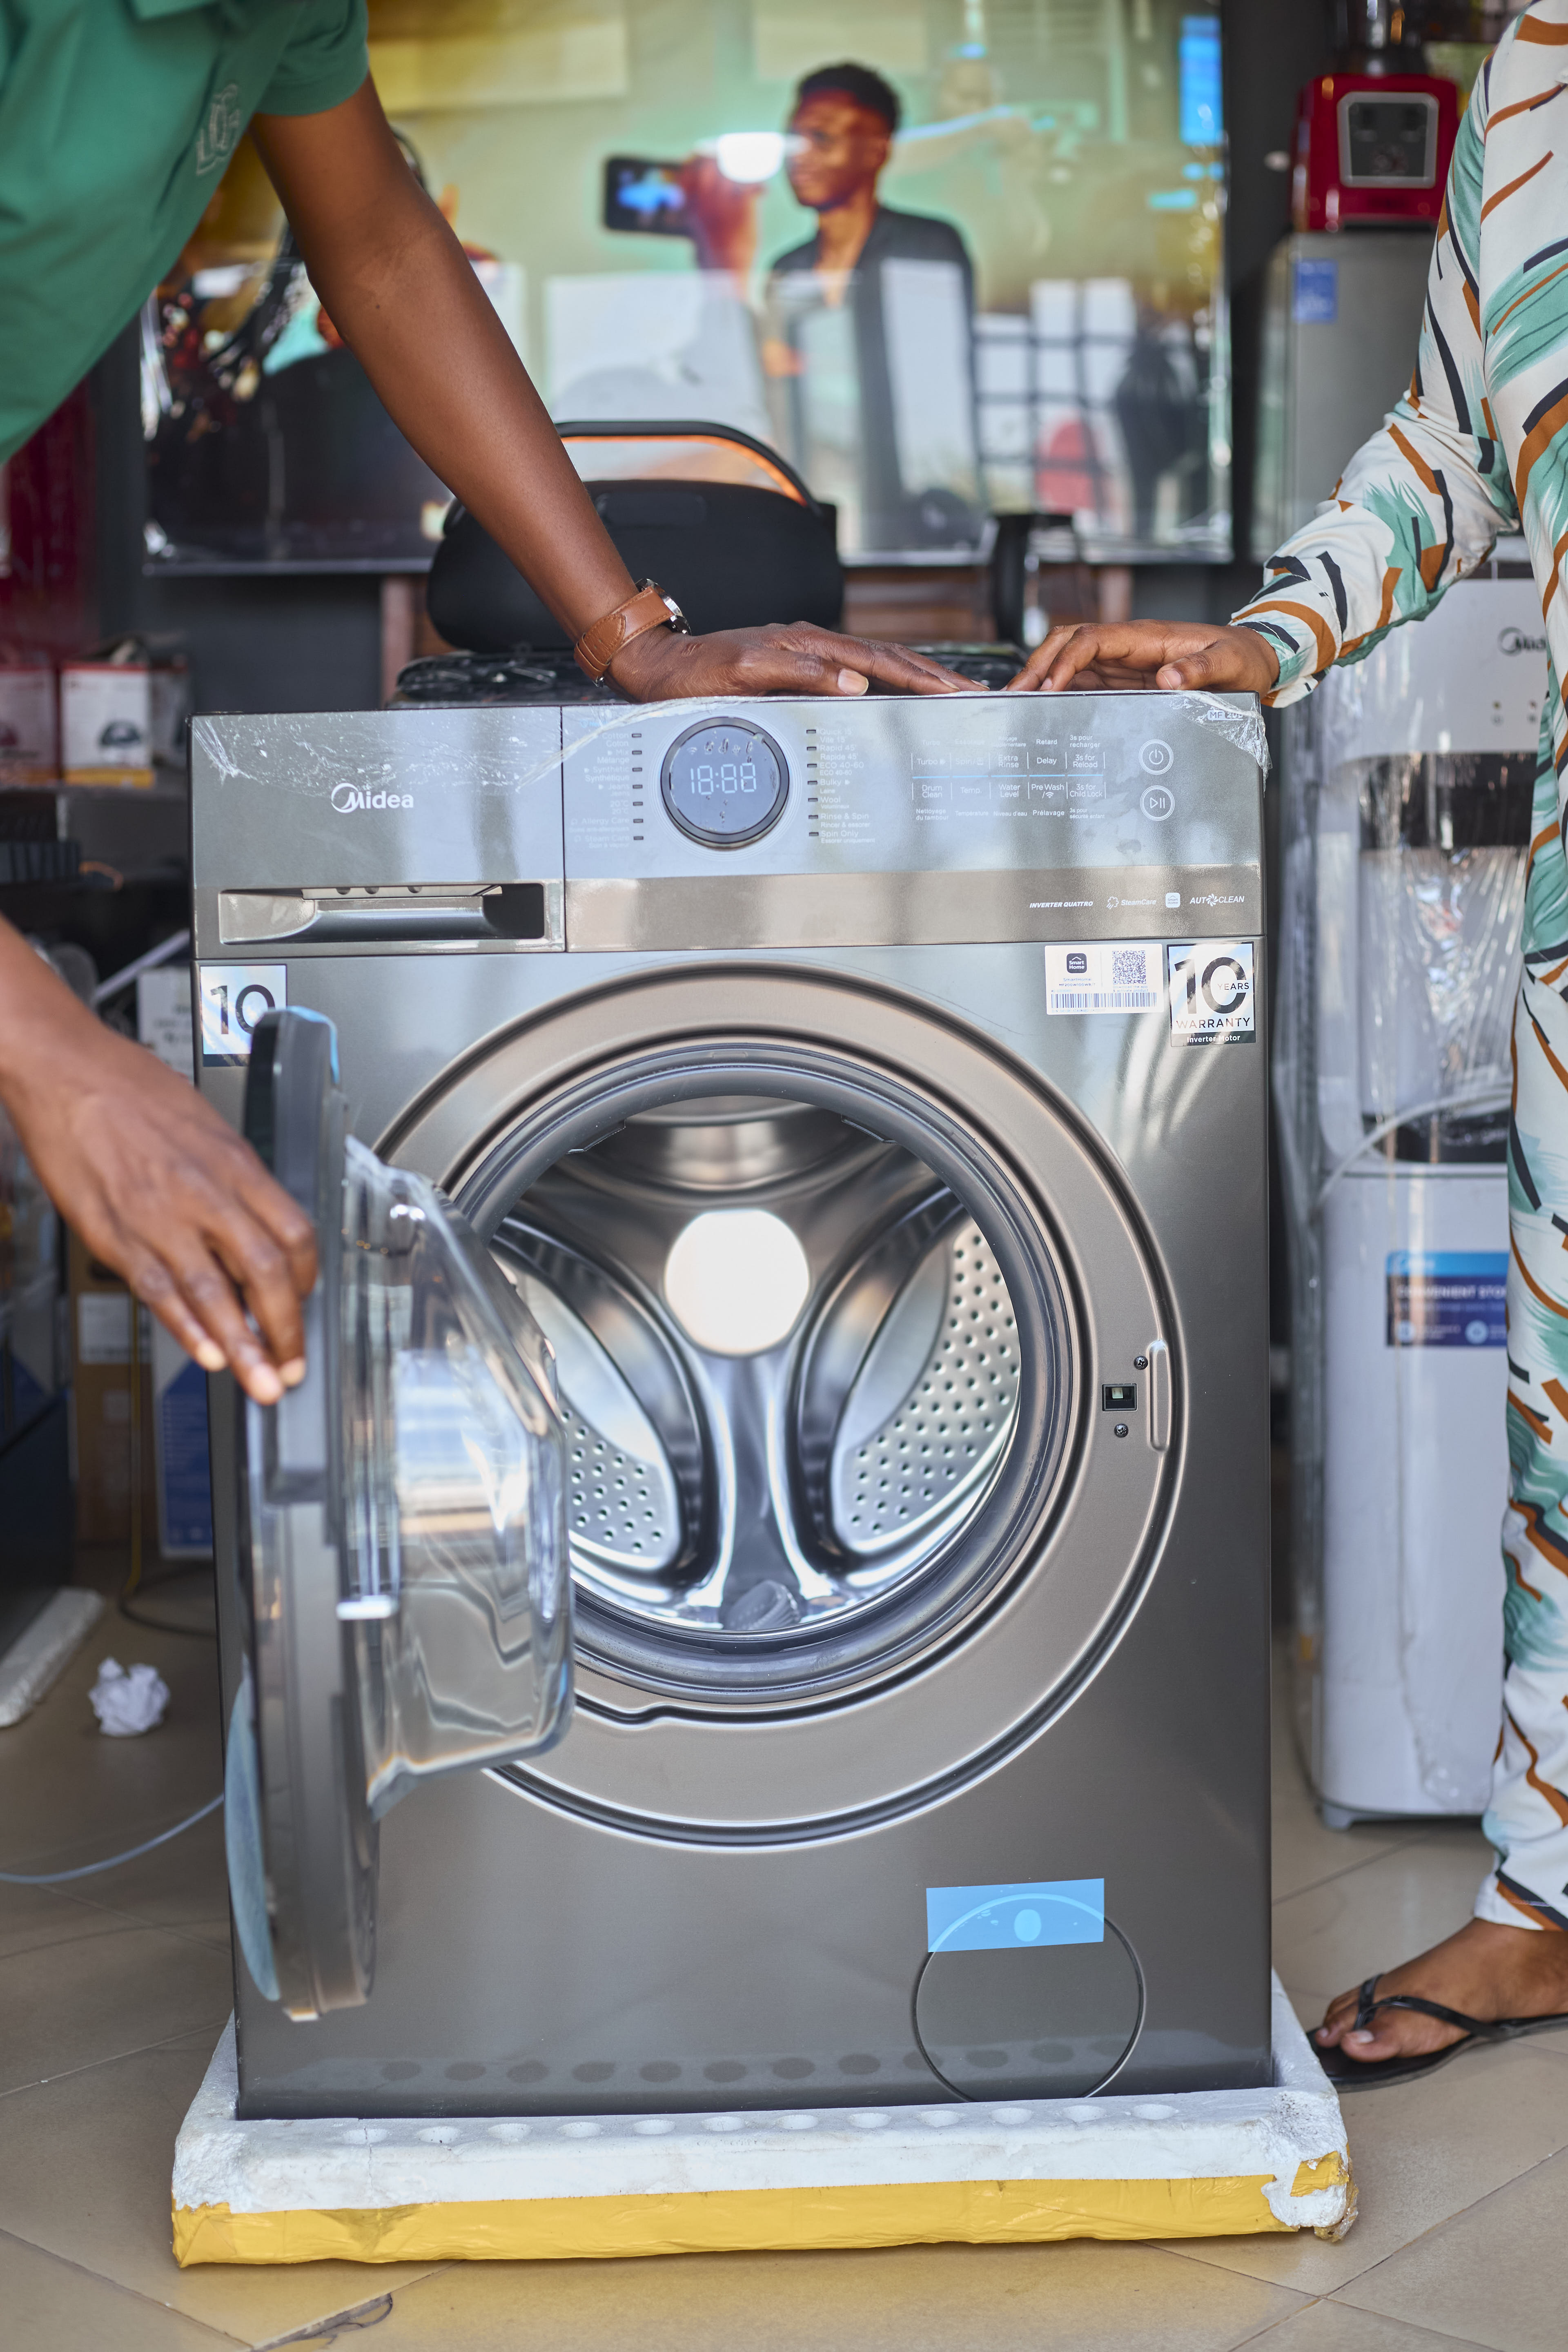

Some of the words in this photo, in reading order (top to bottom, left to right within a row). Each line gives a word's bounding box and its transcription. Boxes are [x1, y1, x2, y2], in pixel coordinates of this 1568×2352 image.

[820, 744, 843, 753] Rapid
[820, 753, 846, 761] Rapide
[820, 778, 842, 786] Bulky
[331, 783, 414, 813] Midea
[581, 817, 609, 826] Allergy
[852, 813, 869, 821] Spin
[1174, 957, 1247, 1014] 10
[1218, 982, 1250, 990] YEARS
[210, 984, 276, 1035] 10
[1176, 1017, 1250, 1029] WARRANTY
[1187, 1035, 1216, 1043] Inverter
